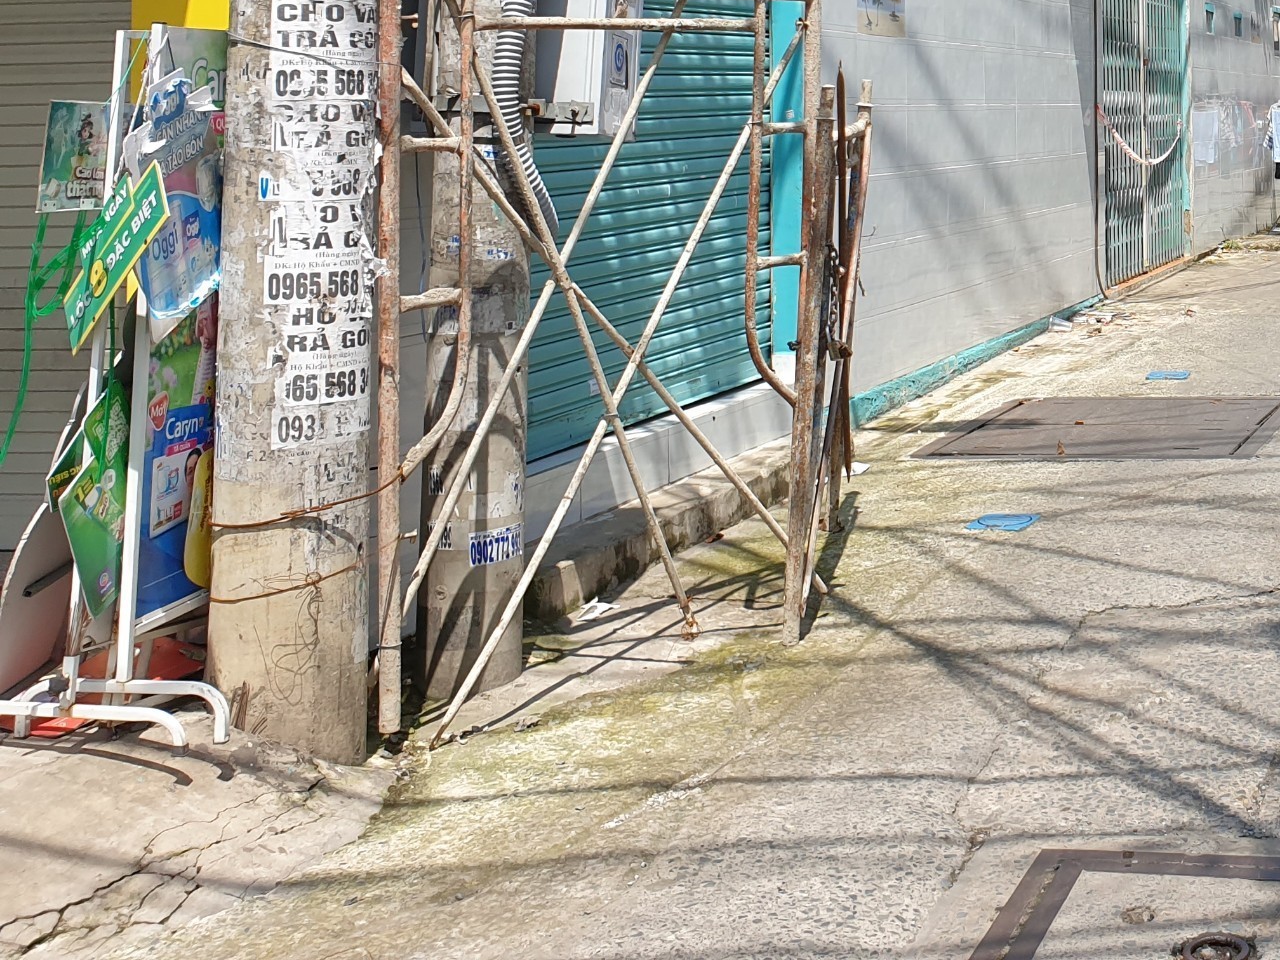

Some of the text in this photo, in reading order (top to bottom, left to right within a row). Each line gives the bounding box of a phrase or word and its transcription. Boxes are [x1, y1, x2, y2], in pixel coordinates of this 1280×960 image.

[276, 3, 346, 23] CHO
[275, 23, 340, 49] TRẢ
[334, 69, 365, 96] 568
[89, 257, 108, 299] 8
[105, 230, 132, 273] ĐẶC
[130, 190, 158, 235] BIỆT
[268, 269, 360, 301] 0965 568
[324, 369, 357, 399] 568
